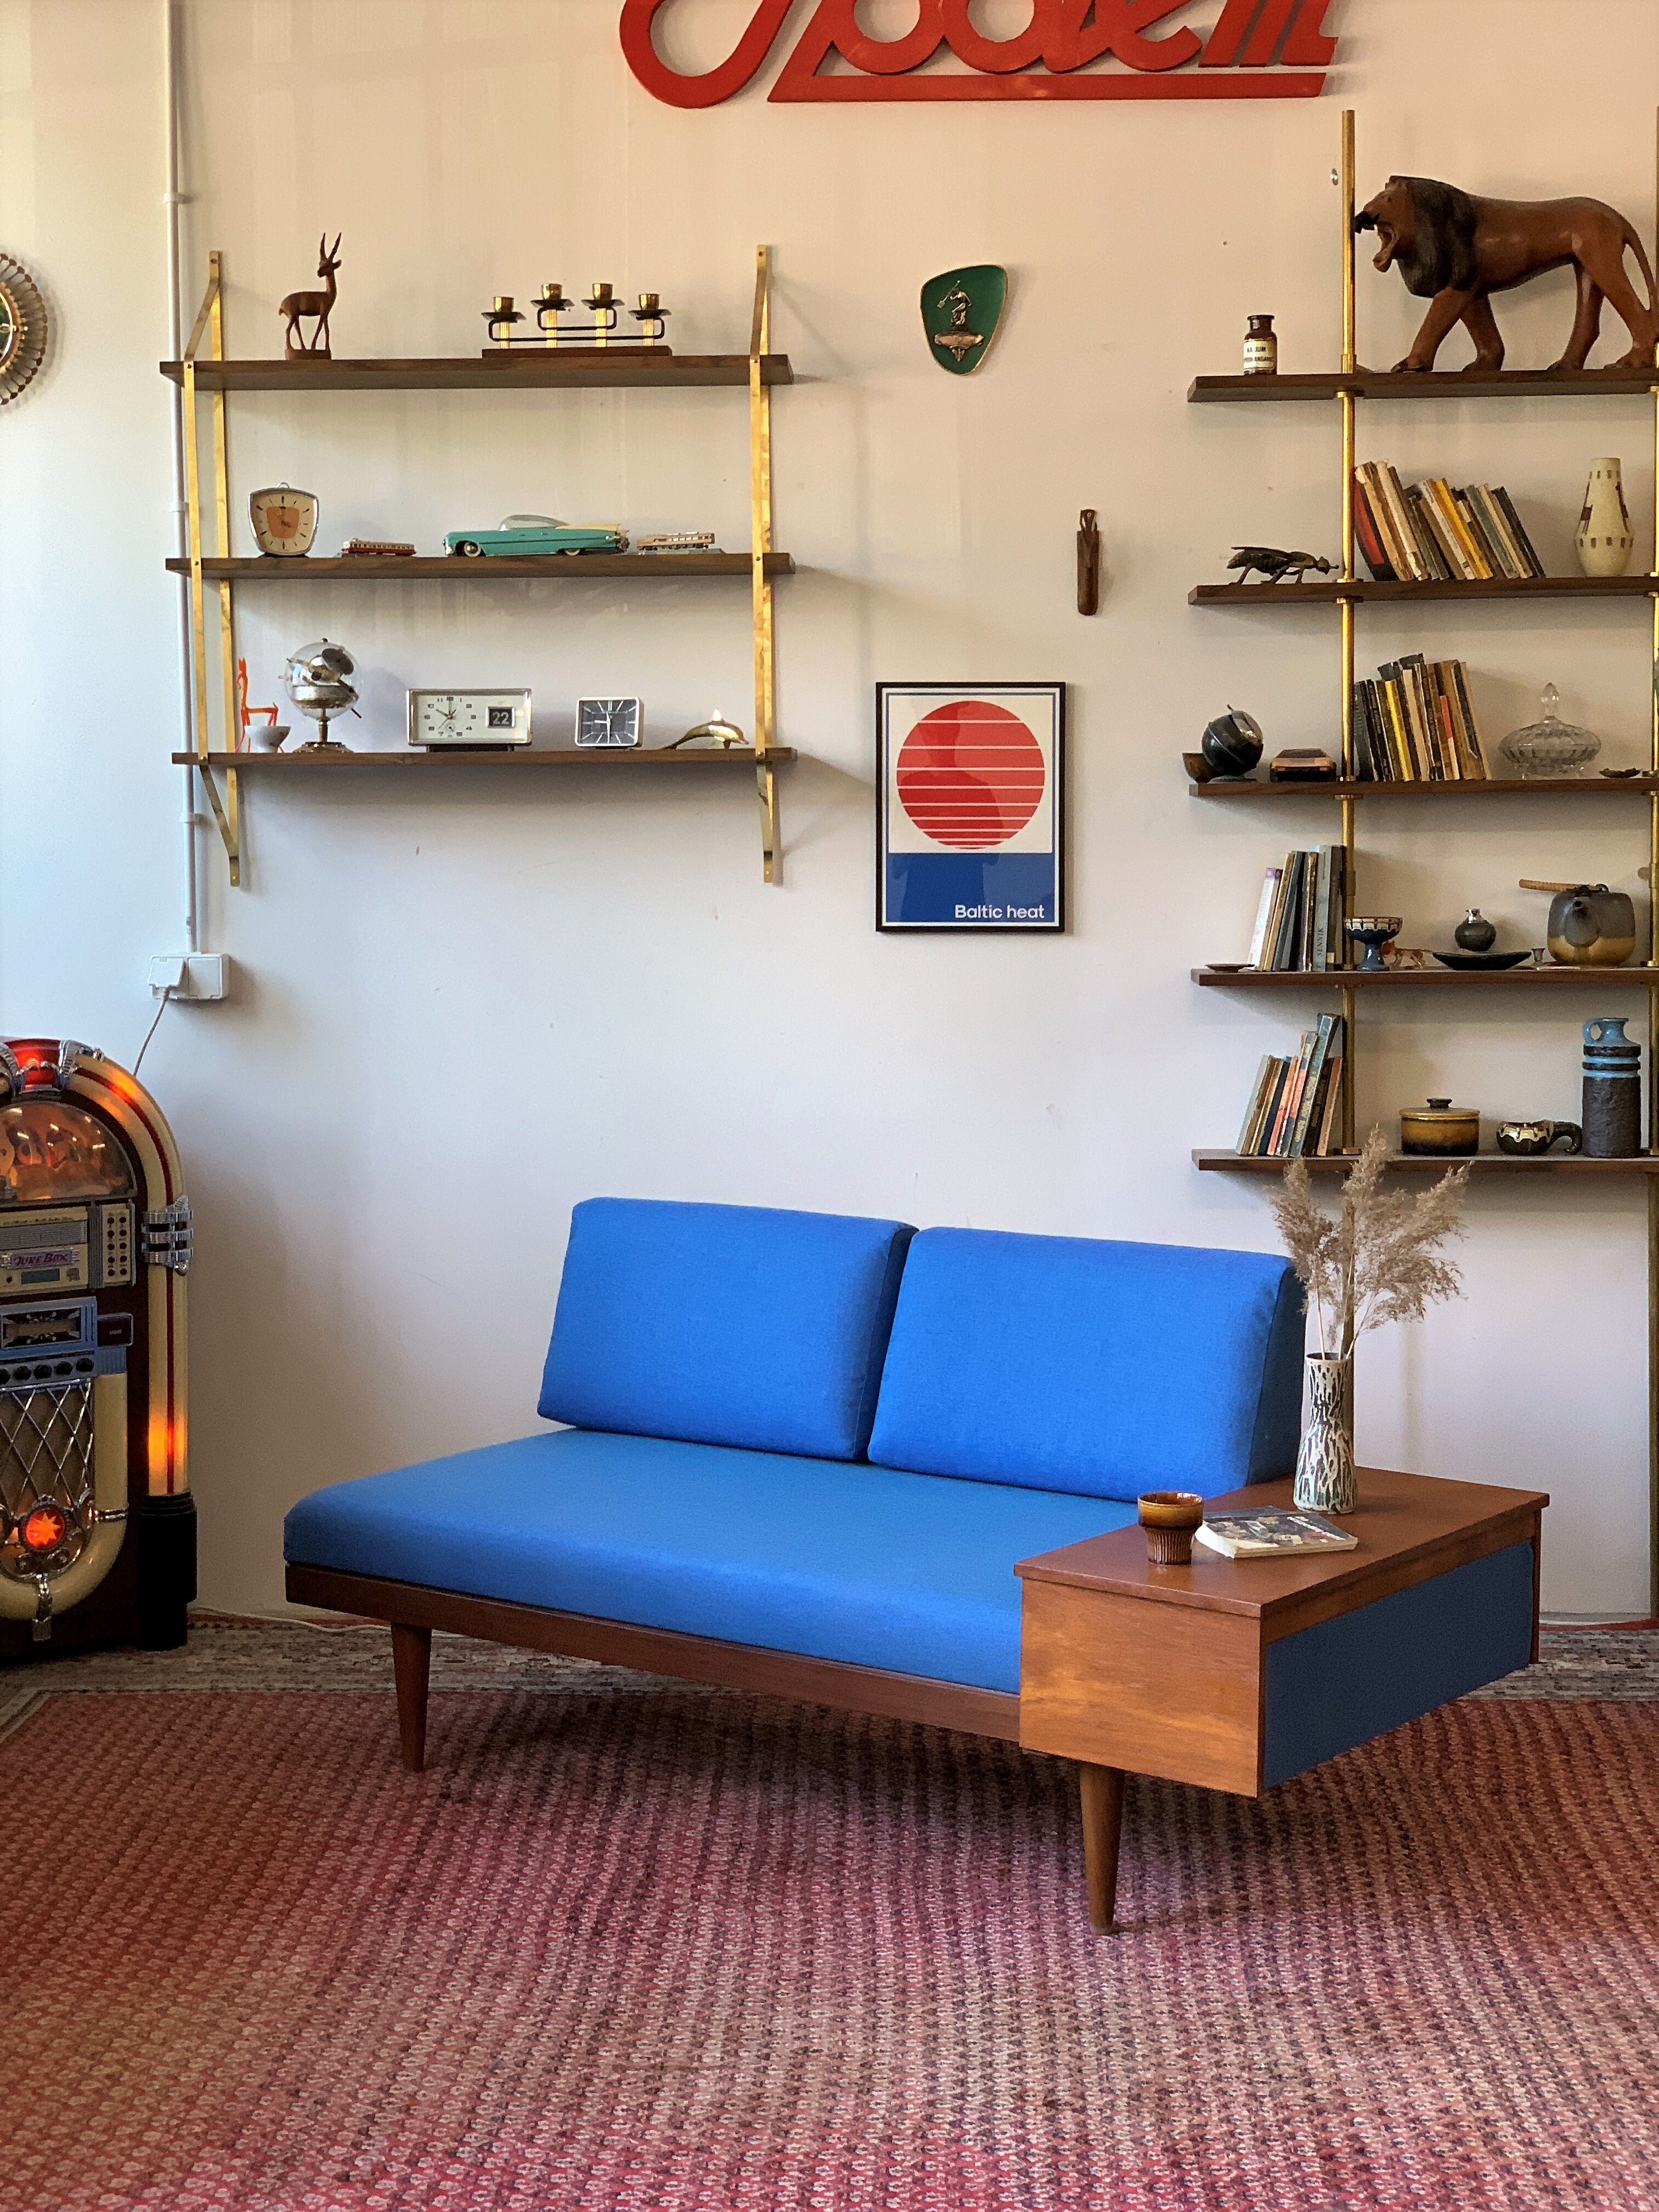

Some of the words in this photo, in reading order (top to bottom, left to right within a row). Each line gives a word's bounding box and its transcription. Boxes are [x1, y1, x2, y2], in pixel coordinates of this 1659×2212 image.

[492, 711, 510, 725] 22
[955, 904, 1003, 919] Baltic
[1006, 904, 1045, 919] heat
